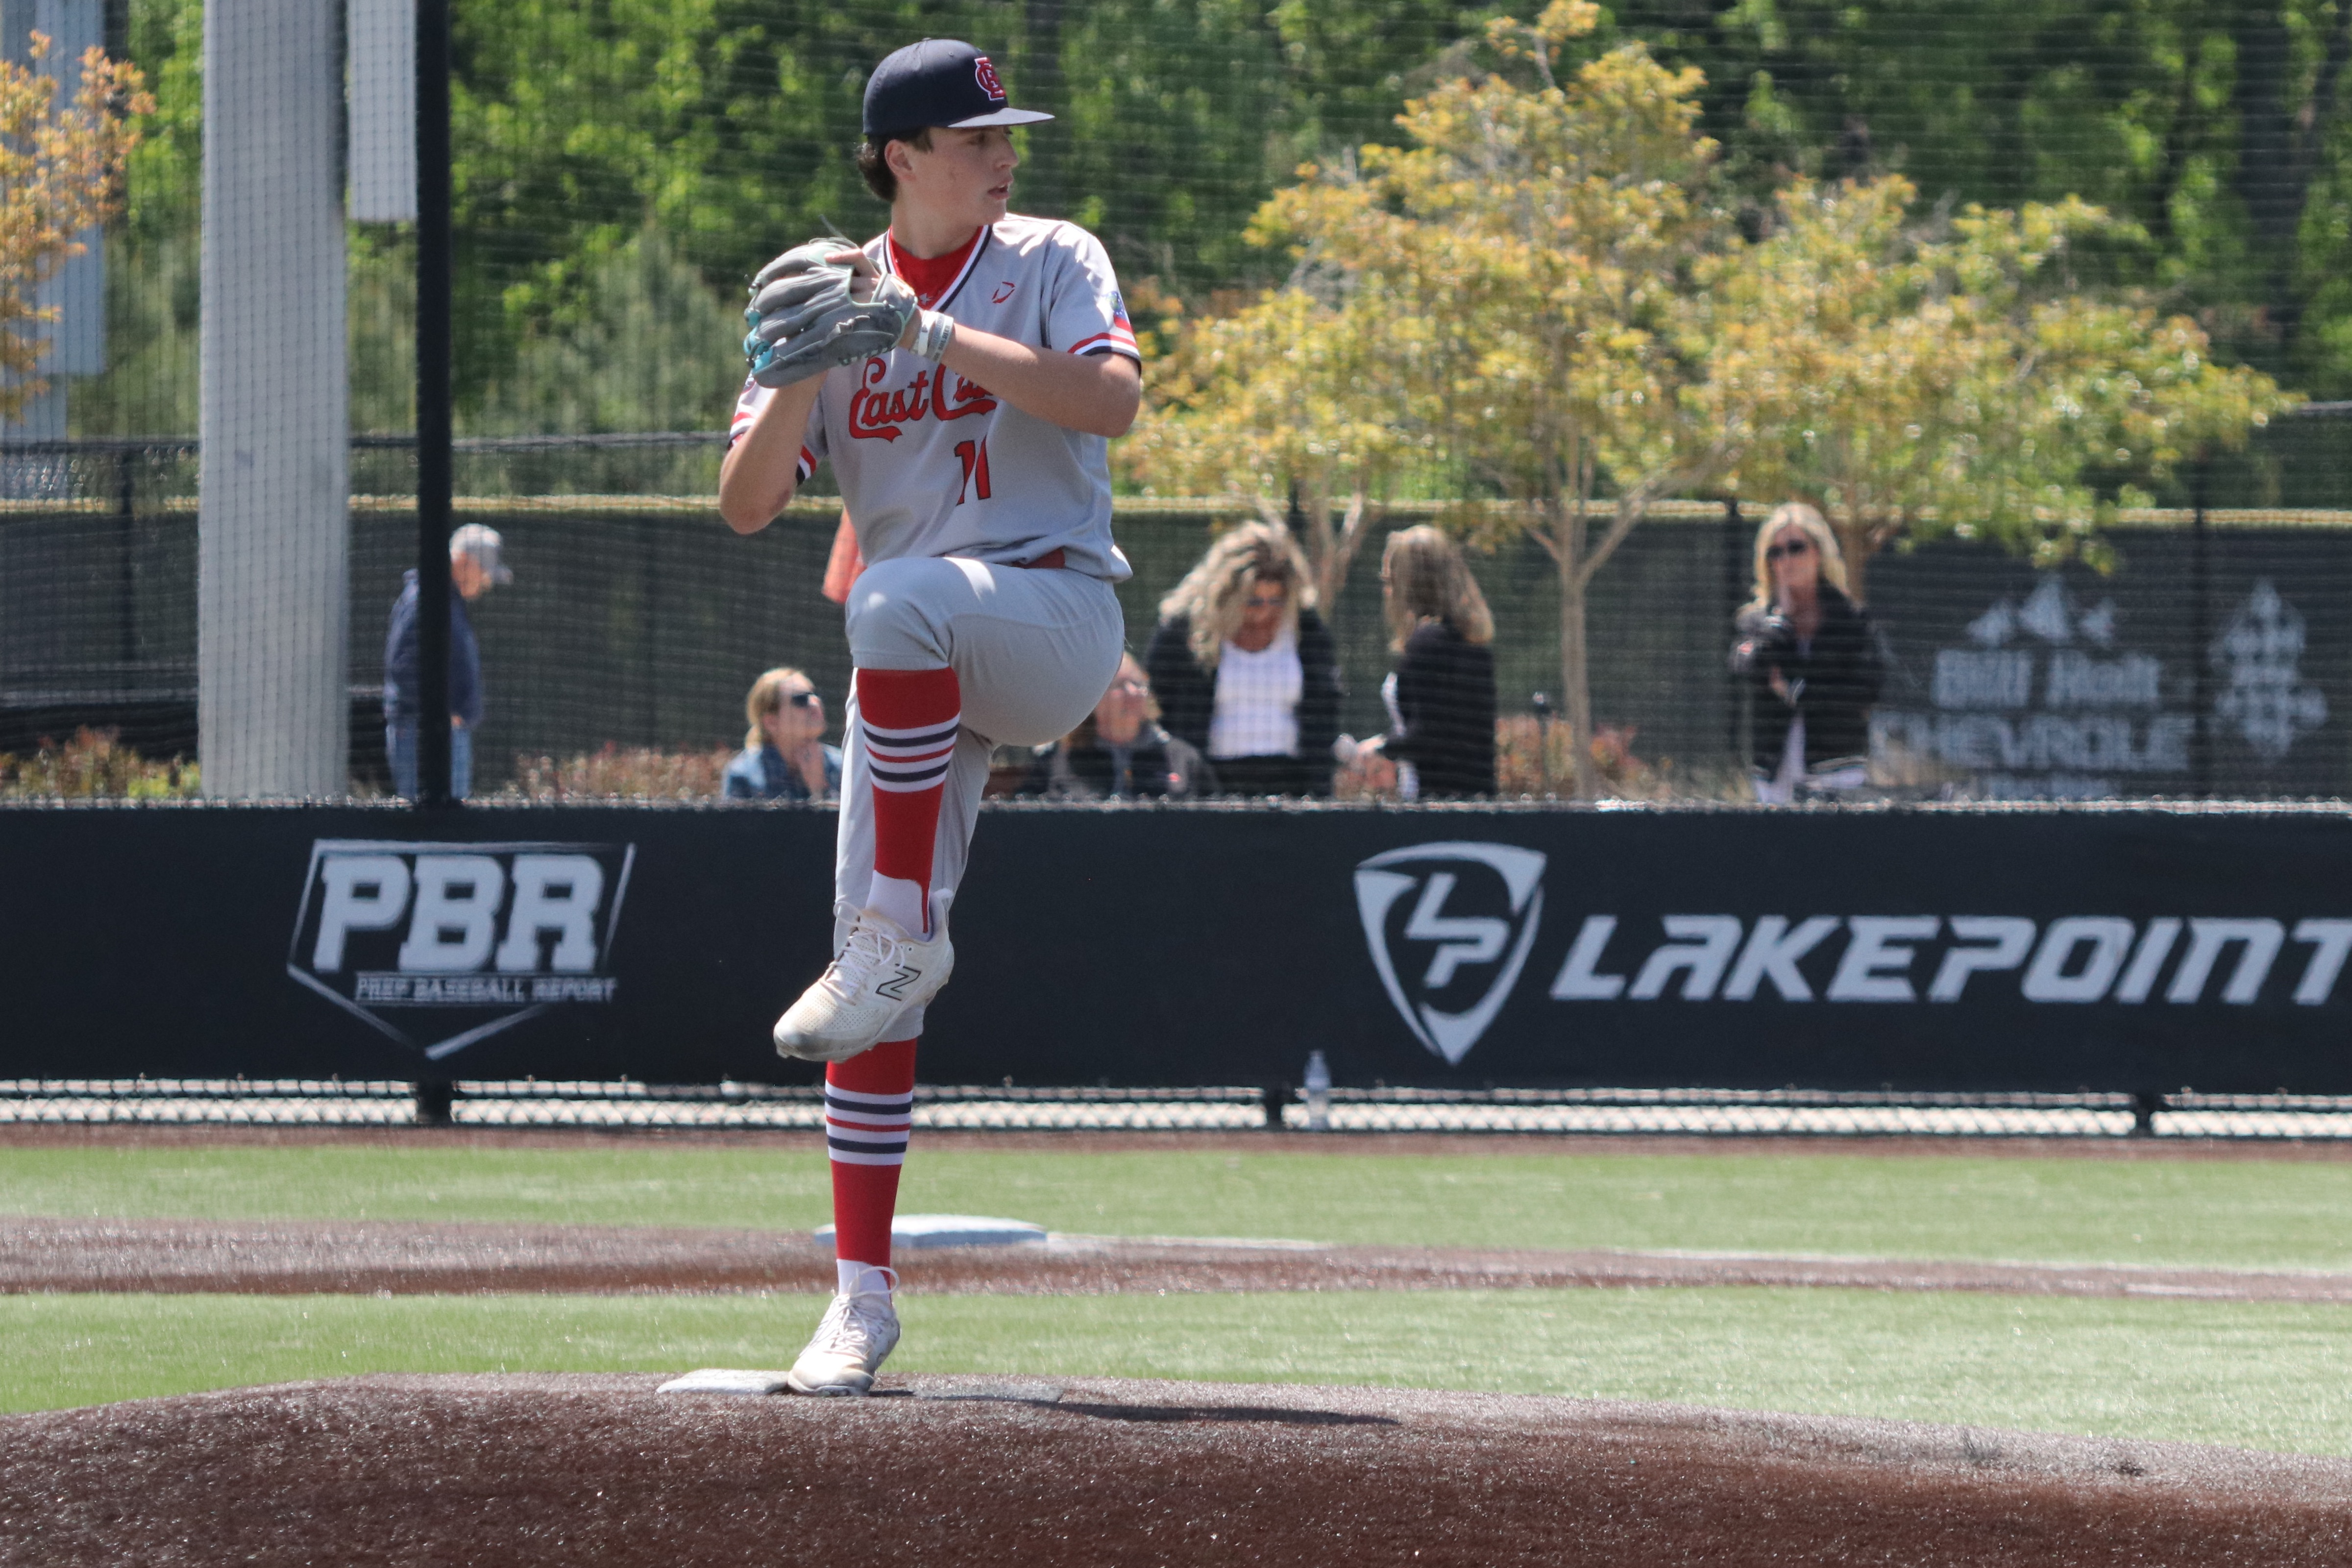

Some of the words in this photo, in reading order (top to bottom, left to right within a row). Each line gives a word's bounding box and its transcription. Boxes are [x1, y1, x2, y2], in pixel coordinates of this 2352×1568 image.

[849, 357, 930, 443] East
[954, 434, 991, 507] 11
[313, 854, 604, 974] PBR
[1404, 872, 1510, 988] LP
[355, 976, 411, 1002] PREP
[413, 977, 527, 1003] BASEBALL
[531, 976, 617, 1004] REPORT
[1549, 914, 2352, 1005] LAKEPOINT
